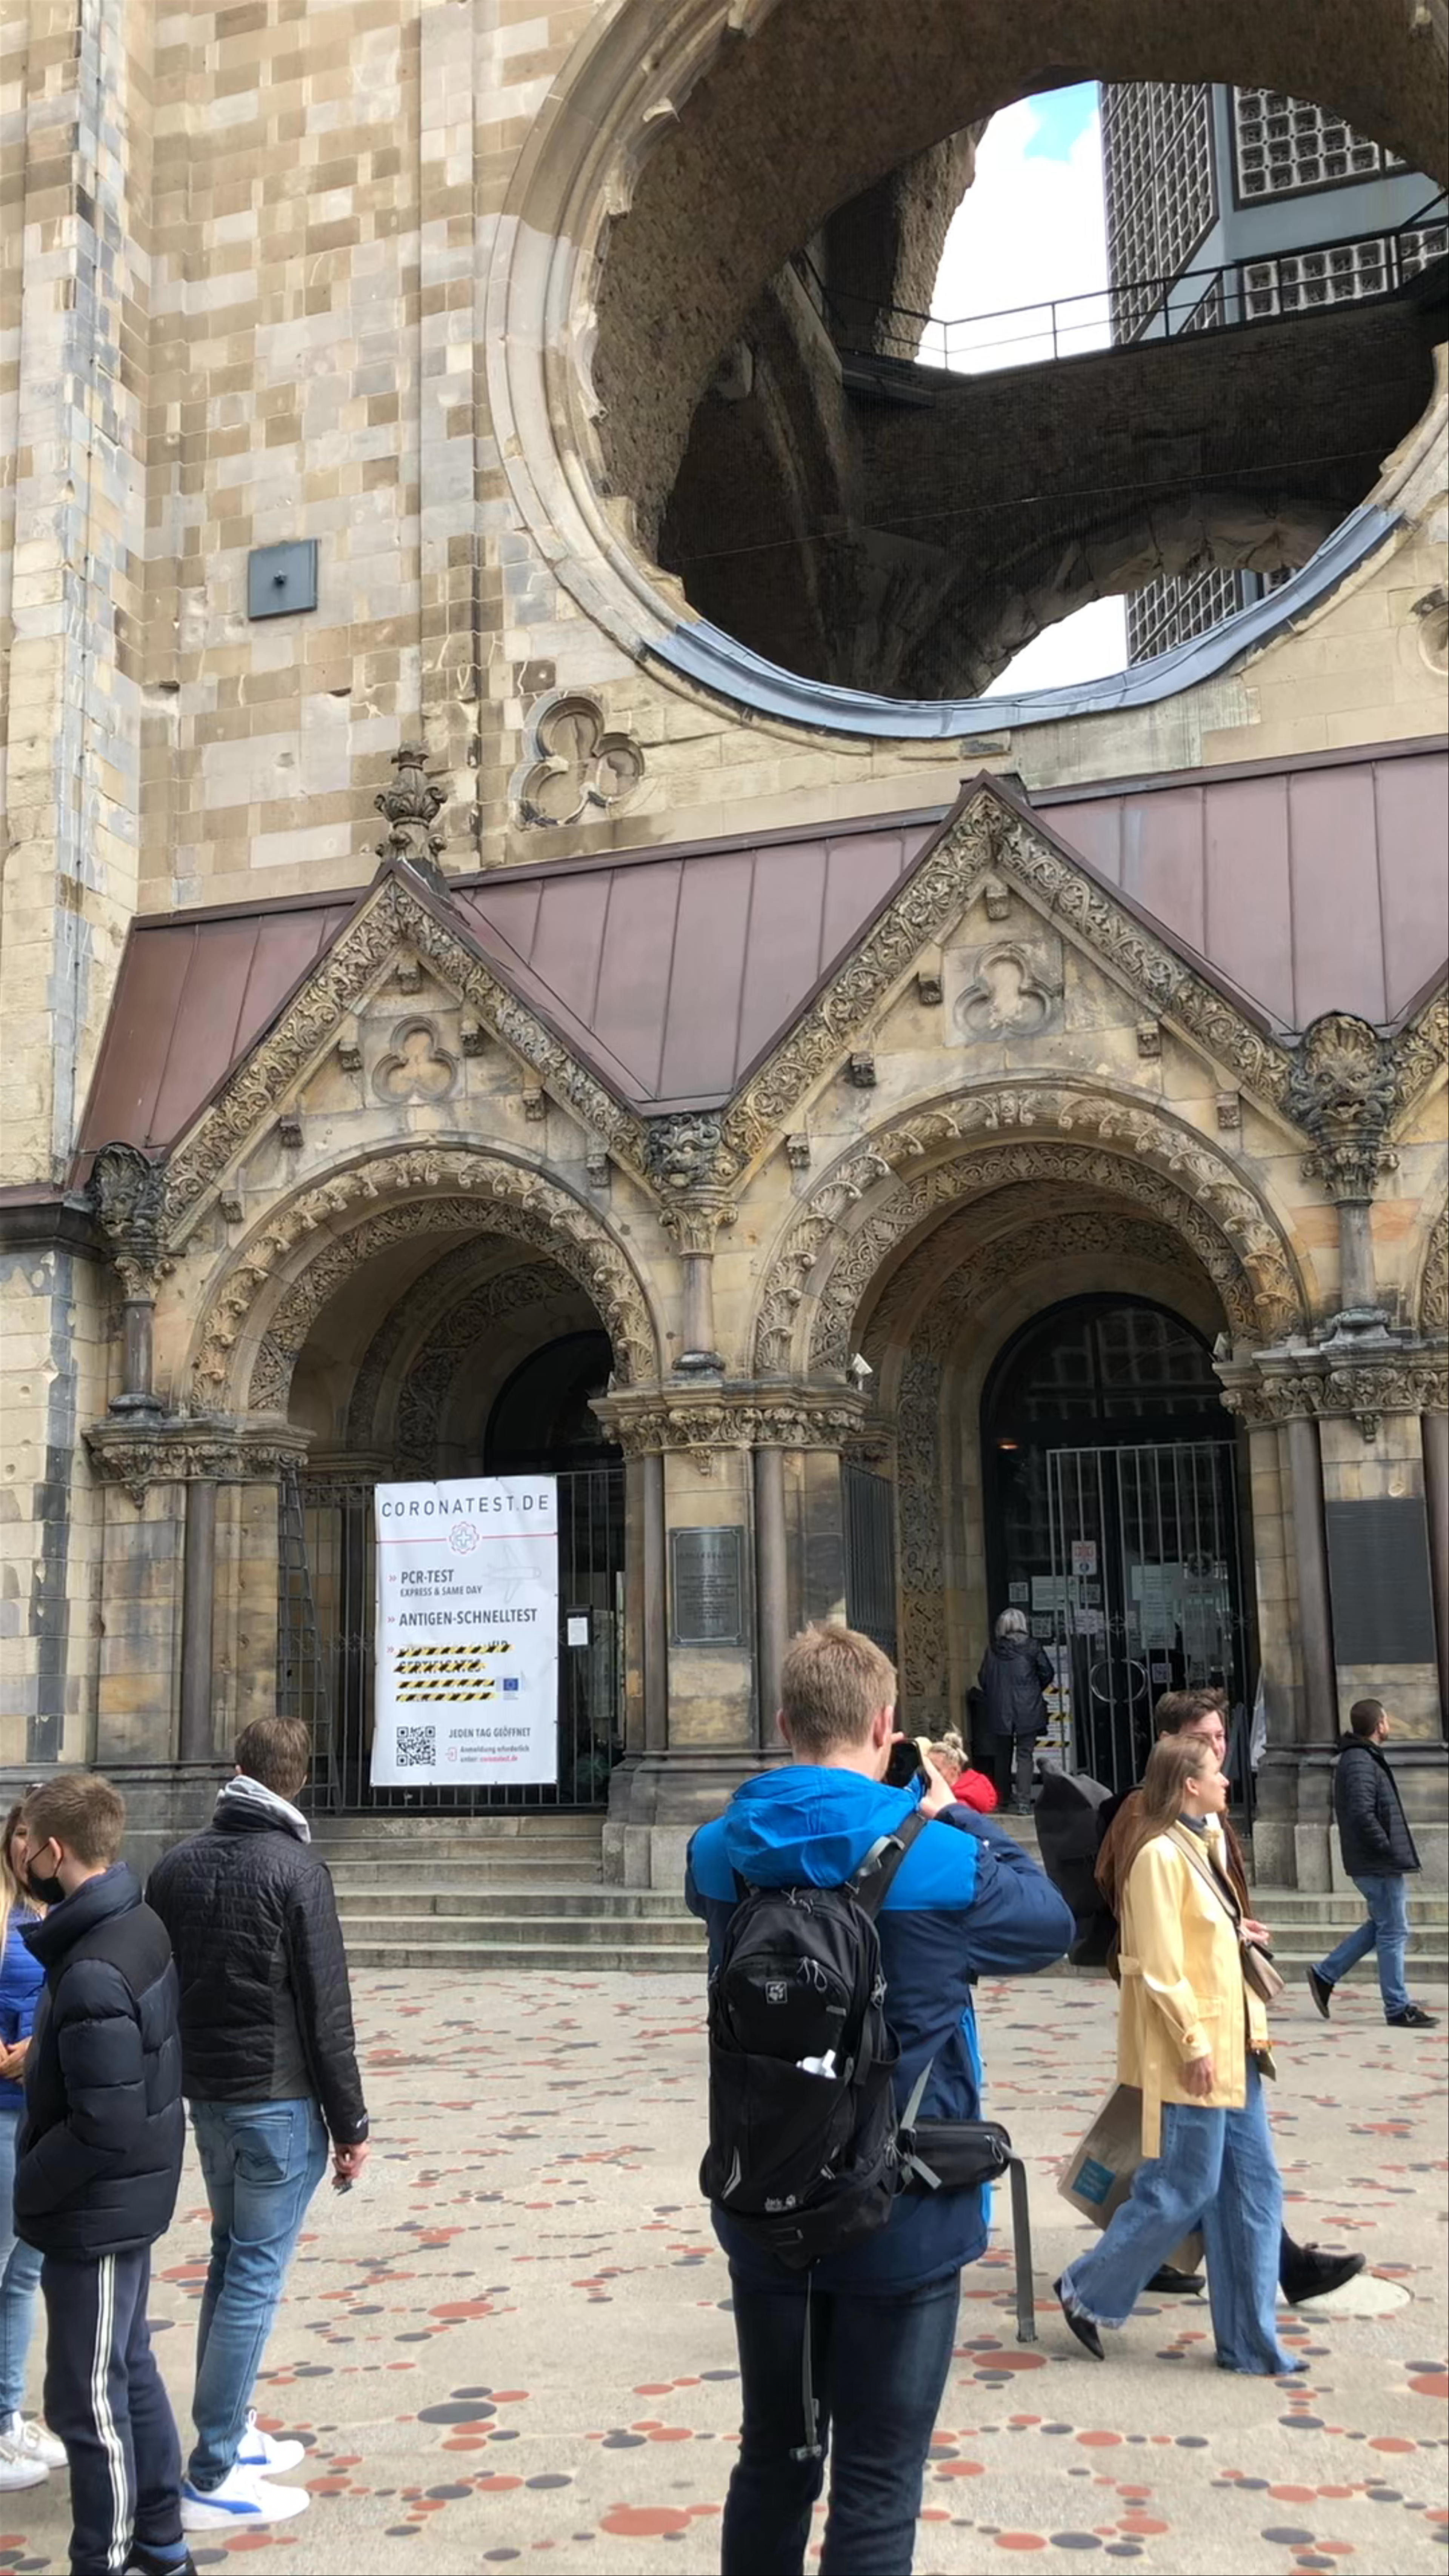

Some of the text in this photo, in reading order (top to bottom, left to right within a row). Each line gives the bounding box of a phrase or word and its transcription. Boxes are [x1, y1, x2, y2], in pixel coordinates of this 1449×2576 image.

[381, 1495, 548, 1517] CORONATEST.DE
[401, 1569, 454, 1584] PCR-TEST
[400, 1587, 432, 1596] EXPRESS
[442, 1586, 463, 1595] SAME
[466, 1586, 482, 1594] DAY
[399, 1609, 537, 1626] ANTIGEN-SCHNELLTEST
[449, 1725, 531, 1738] JEDEN TAG GEÖFFNET
